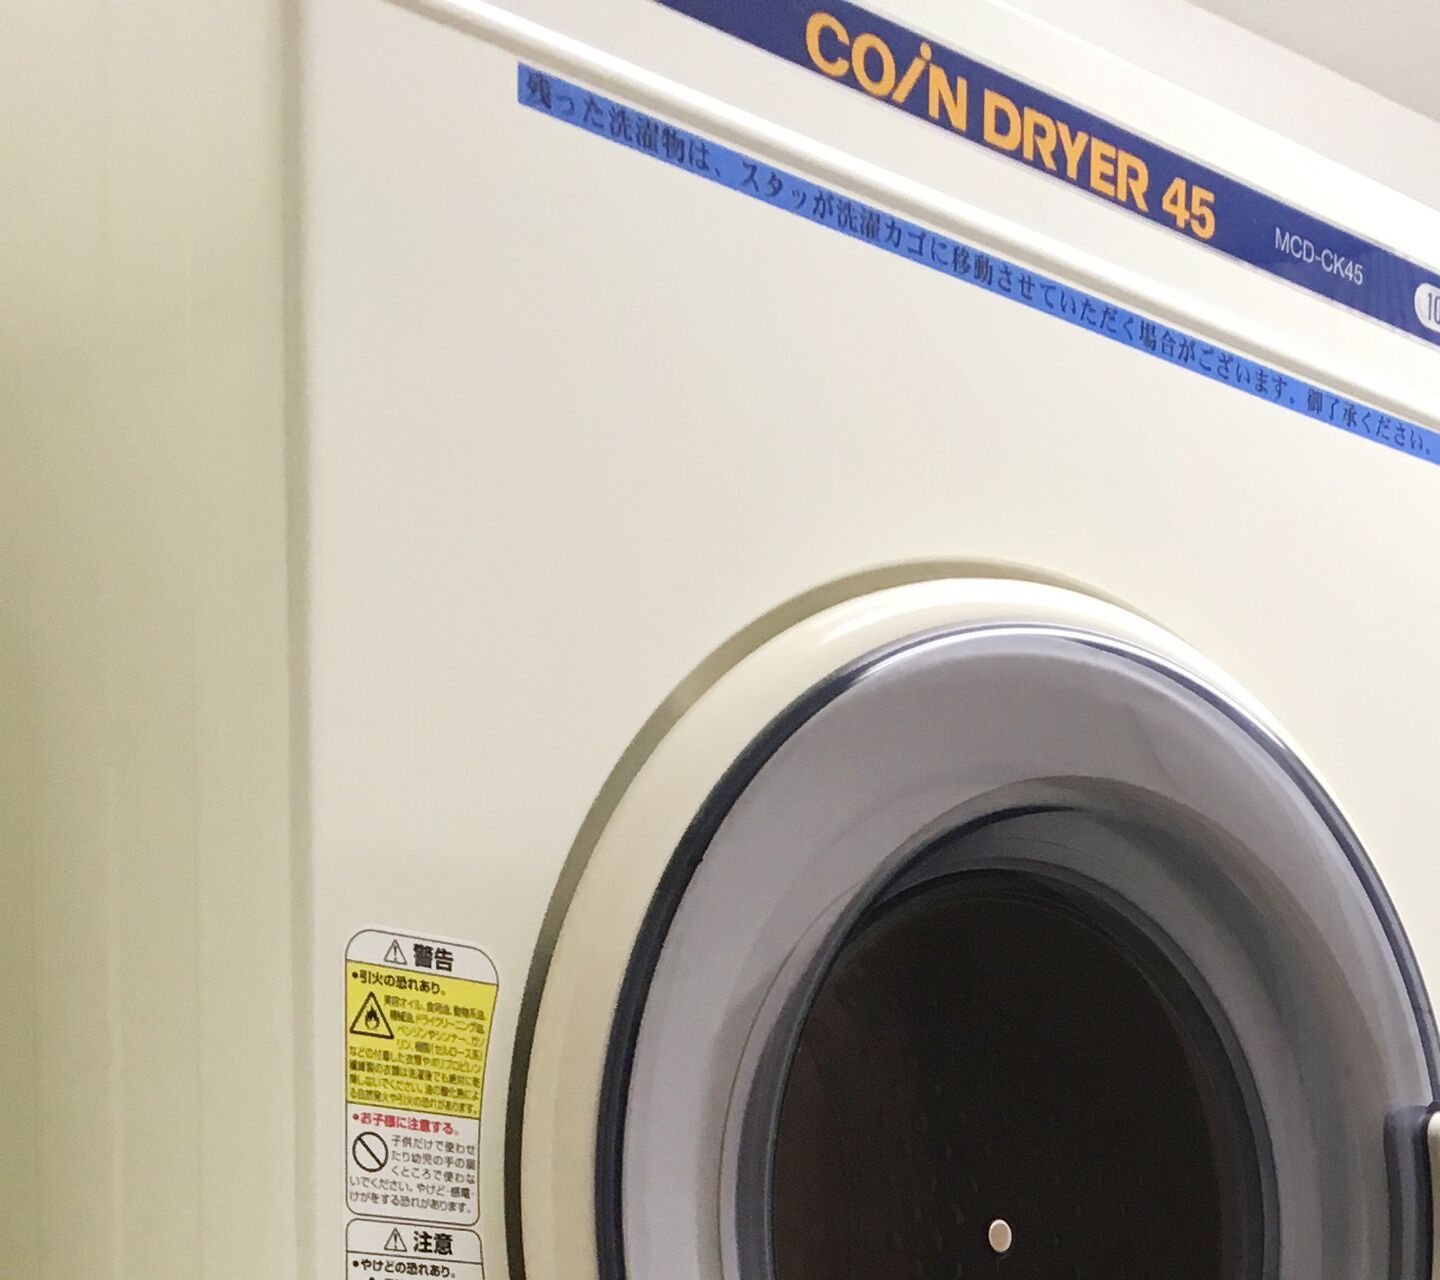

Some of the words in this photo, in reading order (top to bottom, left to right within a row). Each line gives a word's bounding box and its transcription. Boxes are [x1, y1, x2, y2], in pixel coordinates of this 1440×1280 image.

[984, 97, 1150, 212] DRYER
[1161, 173, 1217, 241] 45
[1274, 227, 1365, 288] MCD-CK45
[413, 943, 454, 972] 警告
[359, 969, 446, 996] 引火の恐れあり。
[360, 1112, 459, 1136] お子様に注意する。
[413, 1231, 454, 1256] 注意
[360, 1258, 456, 1279] やけどの恐れあり。
